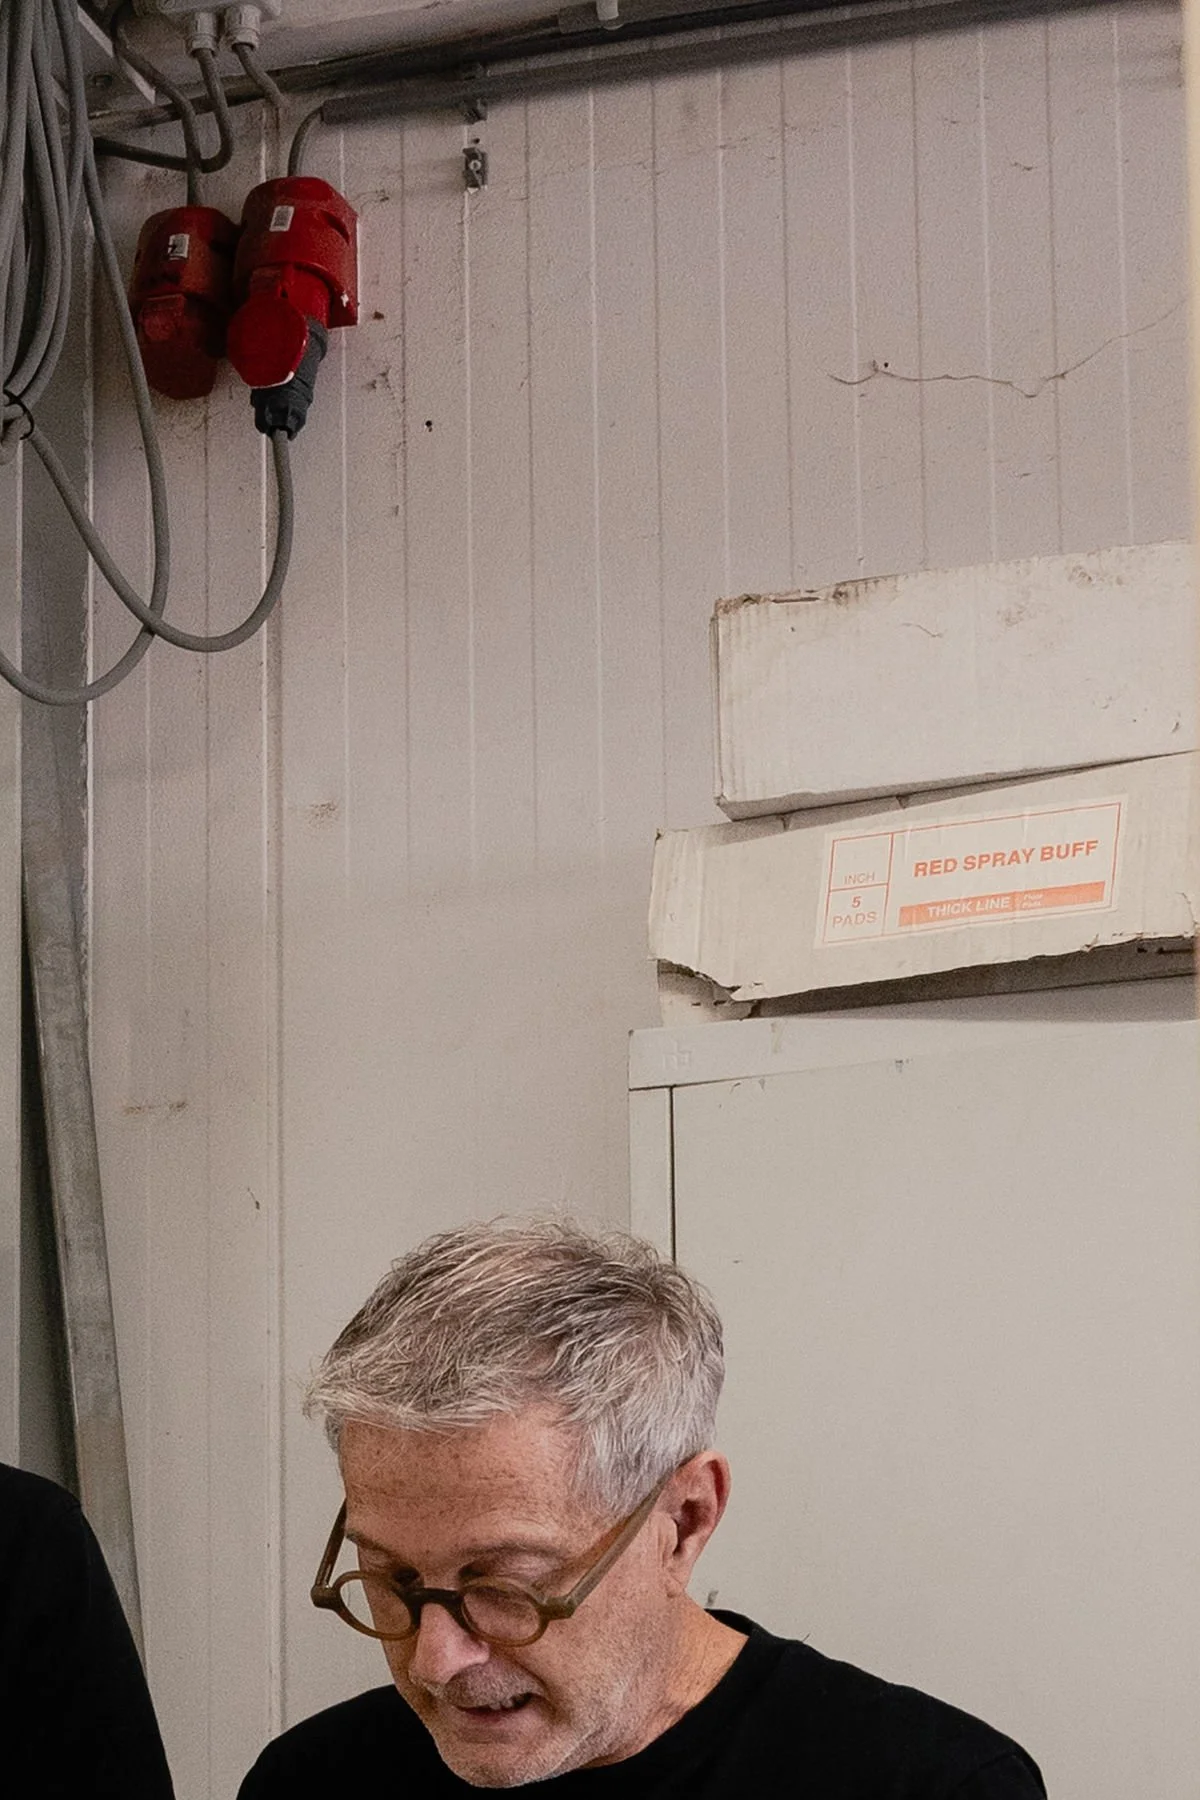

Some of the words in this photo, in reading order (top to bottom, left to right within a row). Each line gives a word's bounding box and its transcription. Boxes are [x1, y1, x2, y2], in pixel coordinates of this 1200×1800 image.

[913, 858, 958, 877] RED
[963, 848, 1035, 871] SPRAY
[1039, 840, 1099, 862] BUFF
[843, 871, 876, 886] INCH
[851, 896, 862, 908] 5
[927, 901, 973, 918] THICK
[975, 897, 1012, 913] LINE
[832, 911, 878, 928] PADS
